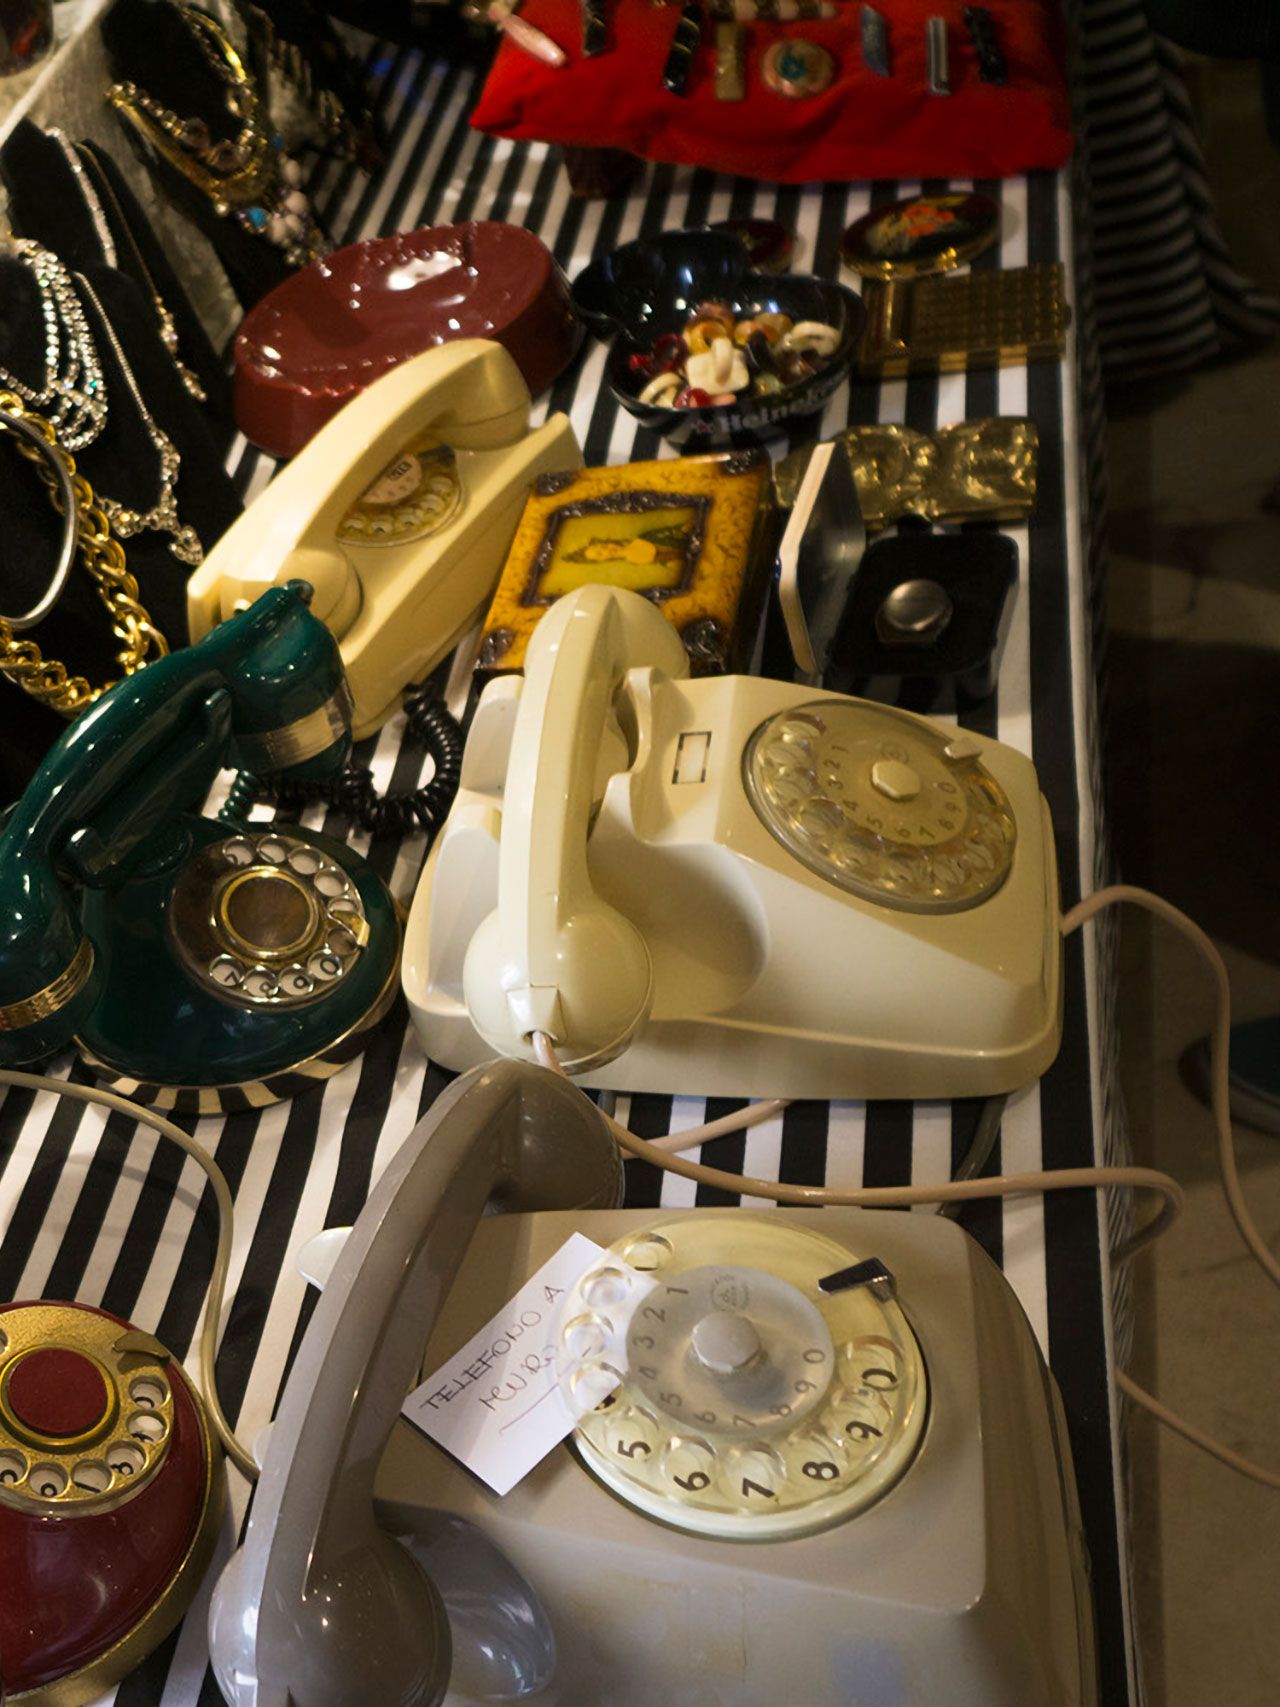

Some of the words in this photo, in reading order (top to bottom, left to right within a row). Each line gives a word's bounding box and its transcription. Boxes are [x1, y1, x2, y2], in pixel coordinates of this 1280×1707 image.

[823, 758, 841, 770] 2
[919, 825, 936, 839] 7
[666, 1286, 689, 1295] 1
[643, 1306, 666, 1323] 2
[420, 1310, 542, 1409] TELEFONO
[544, 1285, 565, 1303] A
[633, 1335, 655, 1350] 3
[803, 1349, 825, 1363] 0
[639, 1364, 658, 1381] 4
[861, 1368, 898, 1391] 0
[794, 1380, 817, 1393] 9
[660, 1392, 682, 1408] 5
[694, 1411, 717, 1424] 6
[771, 1404, 792, 1418] 8
[732, 1415, 756, 1429] 7
[845, 1421, 883, 1441] 9
[617, 1440, 652, 1459] 5
[802, 1461, 840, 1481] 8
[673, 1471, 711, 1491] 6
[742, 1477, 775, 1498] 7
